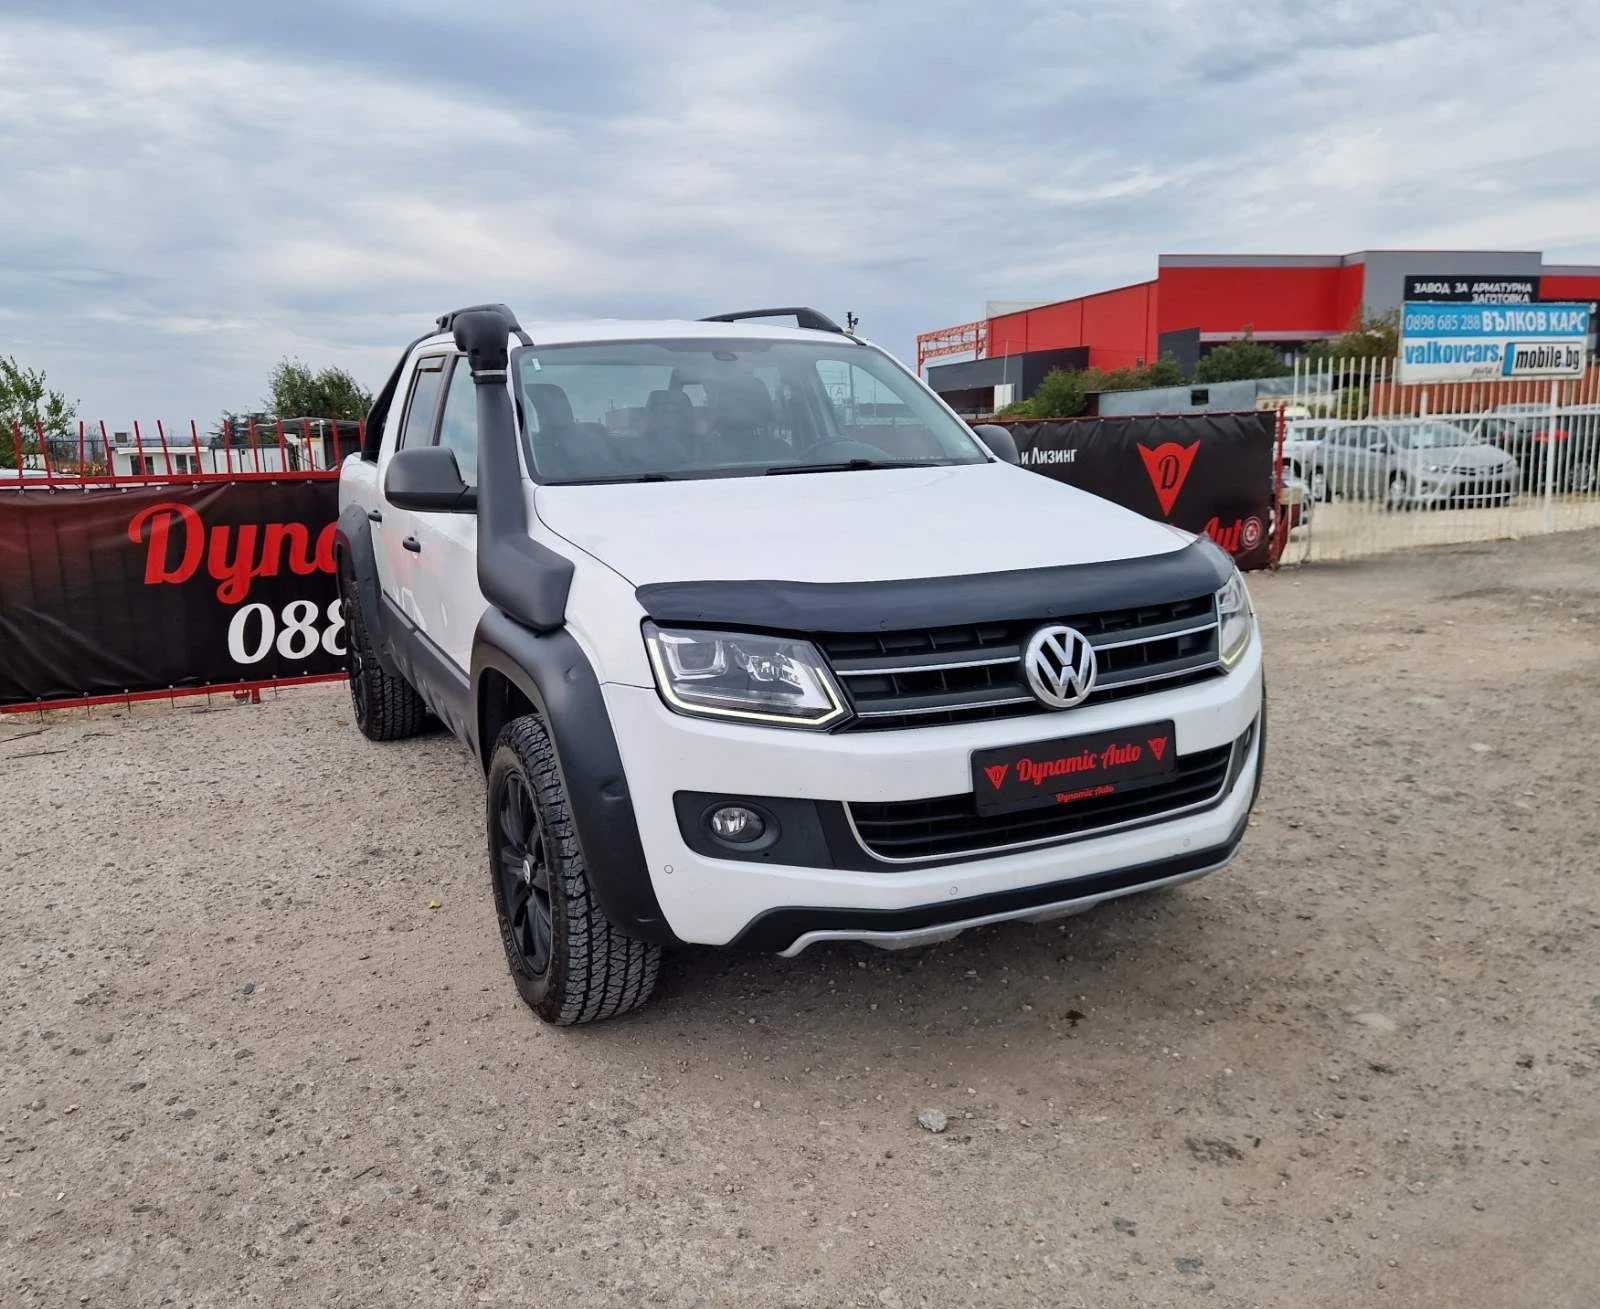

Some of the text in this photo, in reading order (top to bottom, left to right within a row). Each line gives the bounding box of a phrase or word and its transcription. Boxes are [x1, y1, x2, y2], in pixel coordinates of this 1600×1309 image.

[1413, 282, 1450, 295] ЗАВОД
[1454, 282, 1469, 293] ЗА
[1406, 314, 1436, 331] 0898
[1481, 310, 1547, 332] ВЪЛКОВ
[1549, 310, 1586, 332] КАРС
[1515, 346, 1580, 370] mobile.bg
[1021, 446, 1077, 465] и Лизинг
[1016, 751, 1098, 786] Dynamic
[1101, 743, 1142, 769] Auto
[1055, 788, 1096, 804] Dynamic
